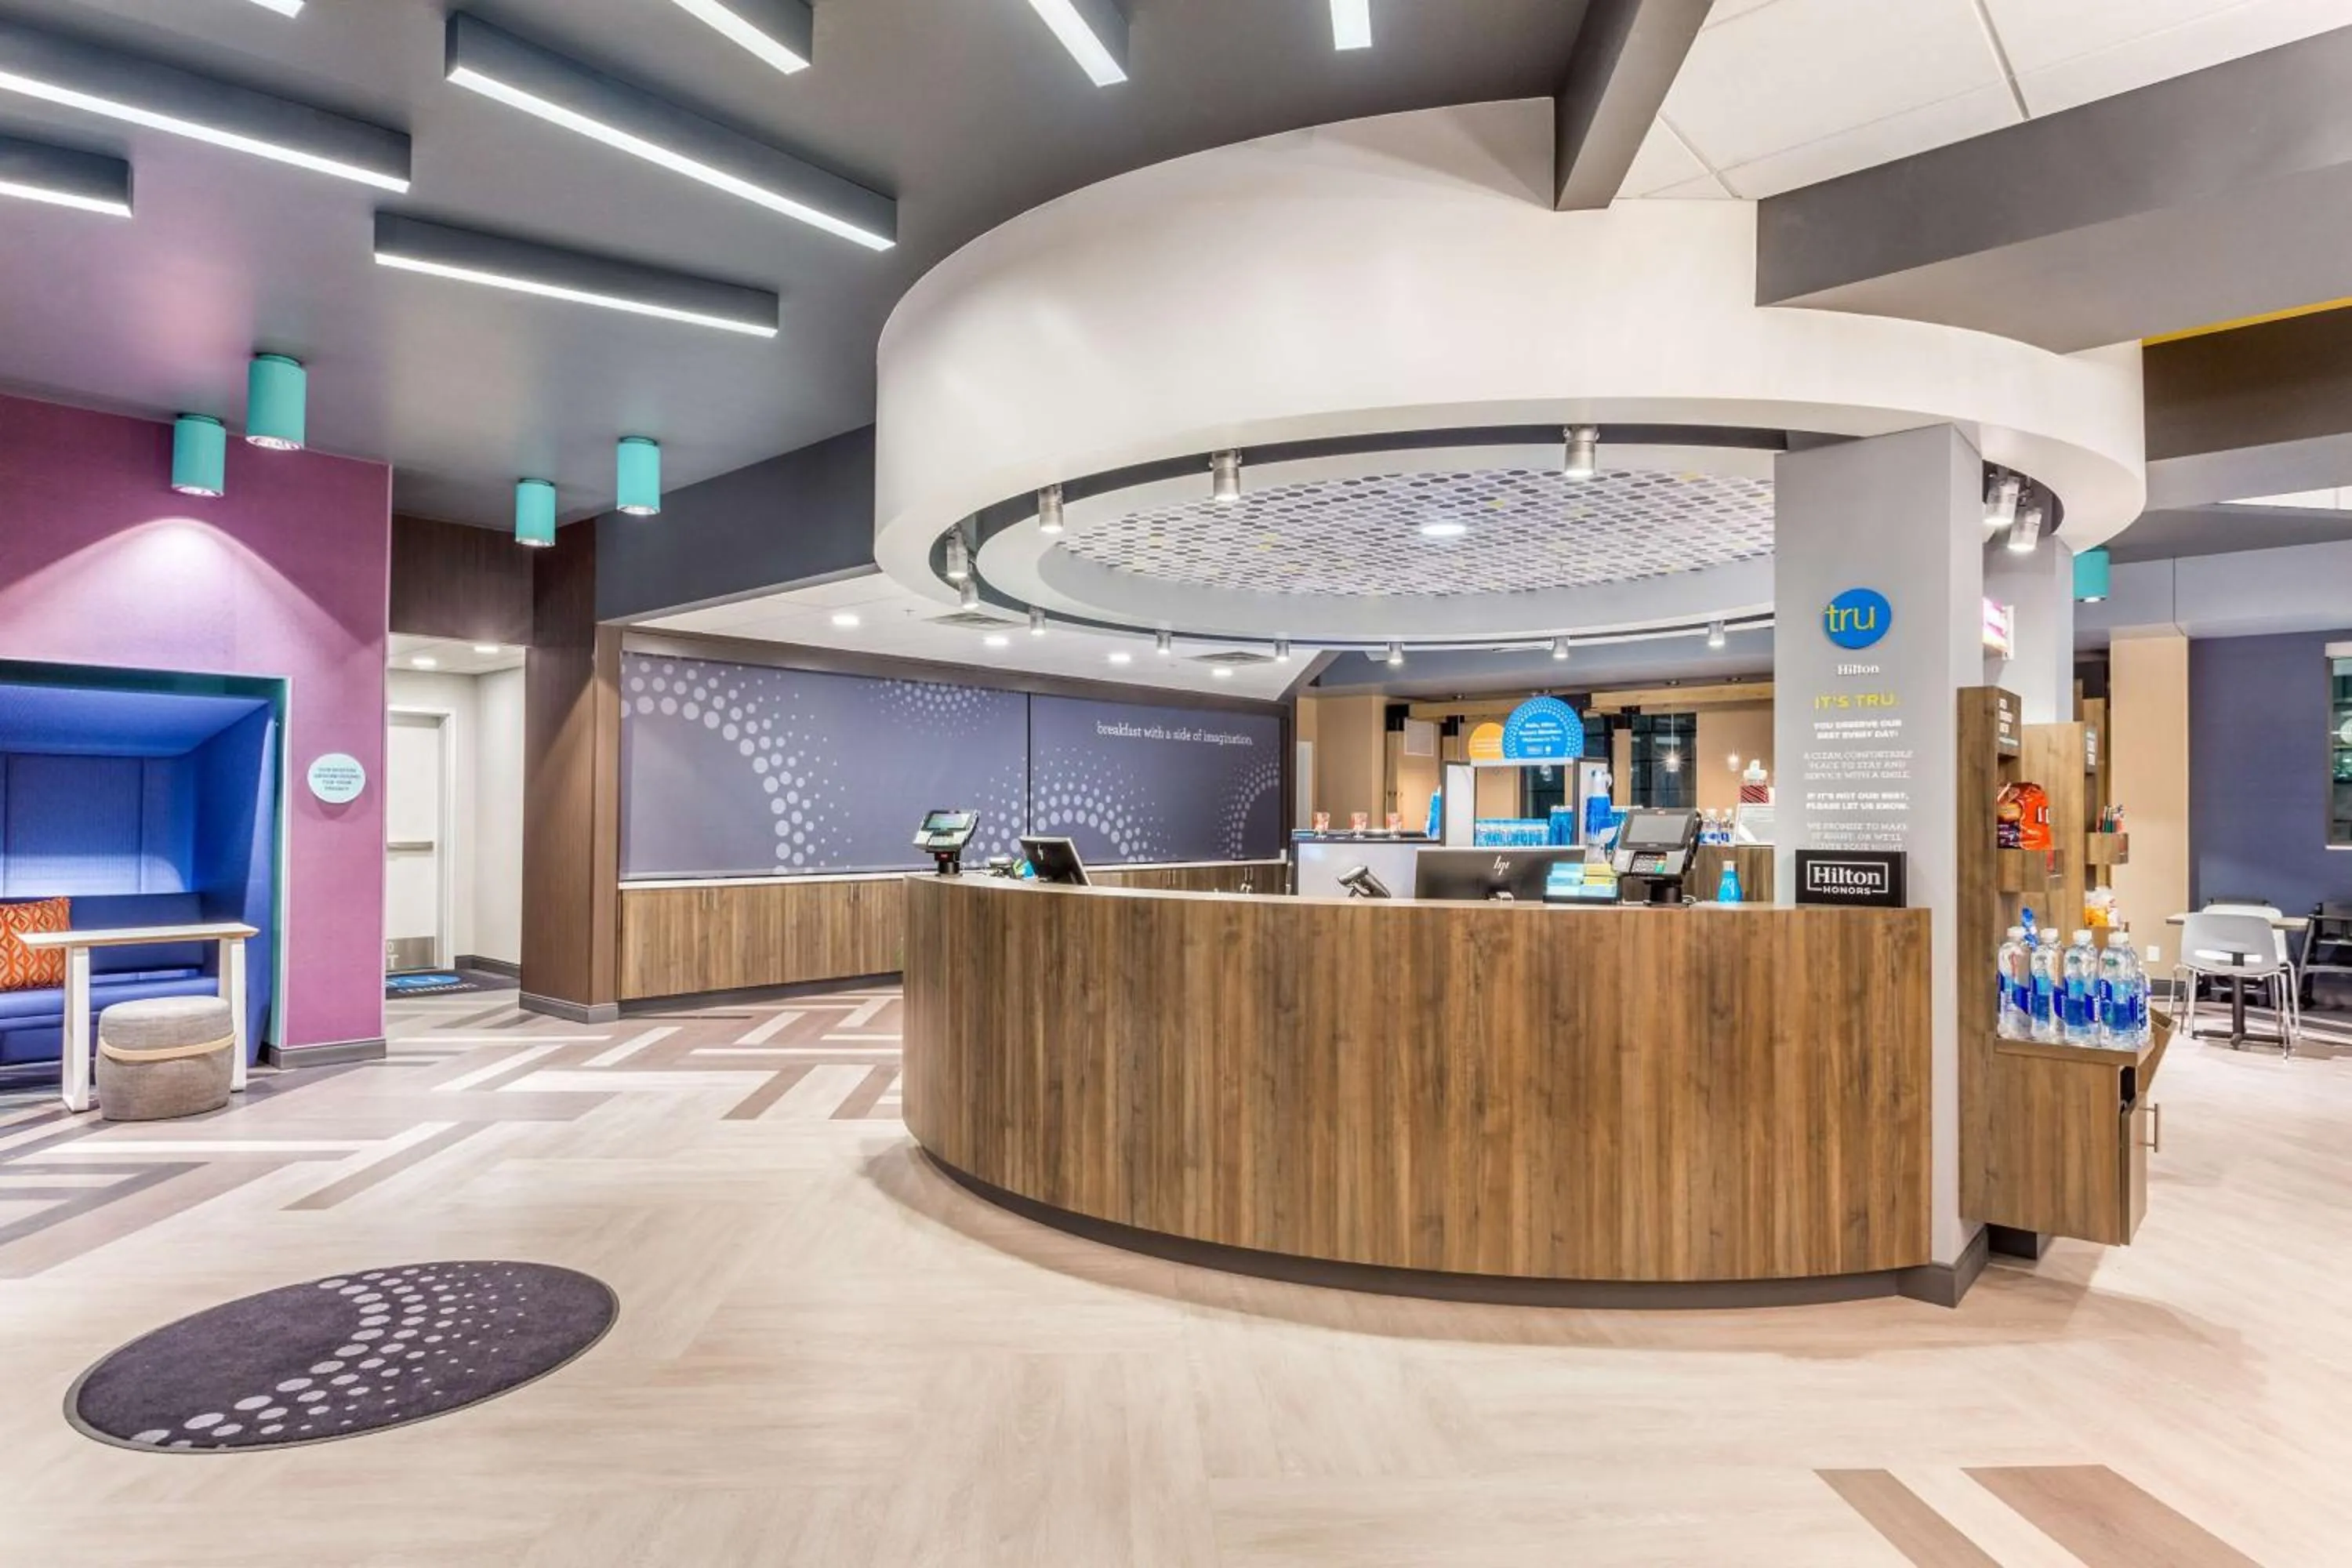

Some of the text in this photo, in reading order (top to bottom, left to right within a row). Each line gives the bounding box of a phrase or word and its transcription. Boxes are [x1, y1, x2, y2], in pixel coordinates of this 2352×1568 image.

[1820, 603, 1876, 633] tru
[1837, 664, 1880, 676] Hilton
[1814, 694, 1851, 710] IT'S
[1097, 720, 1142, 739] breakfast
[1144, 724, 1164, 739] with
[1165, 730, 1172, 739] a
[1173, 727, 1192, 742] side
[1192, 728, 1202, 741] of
[1835, 720, 1879, 729] DESERVE
[1817, 731, 1840, 739] BEST
[1813, 866, 1882, 885] Hilton
[1823, 886, 1871, 895] HONORS
